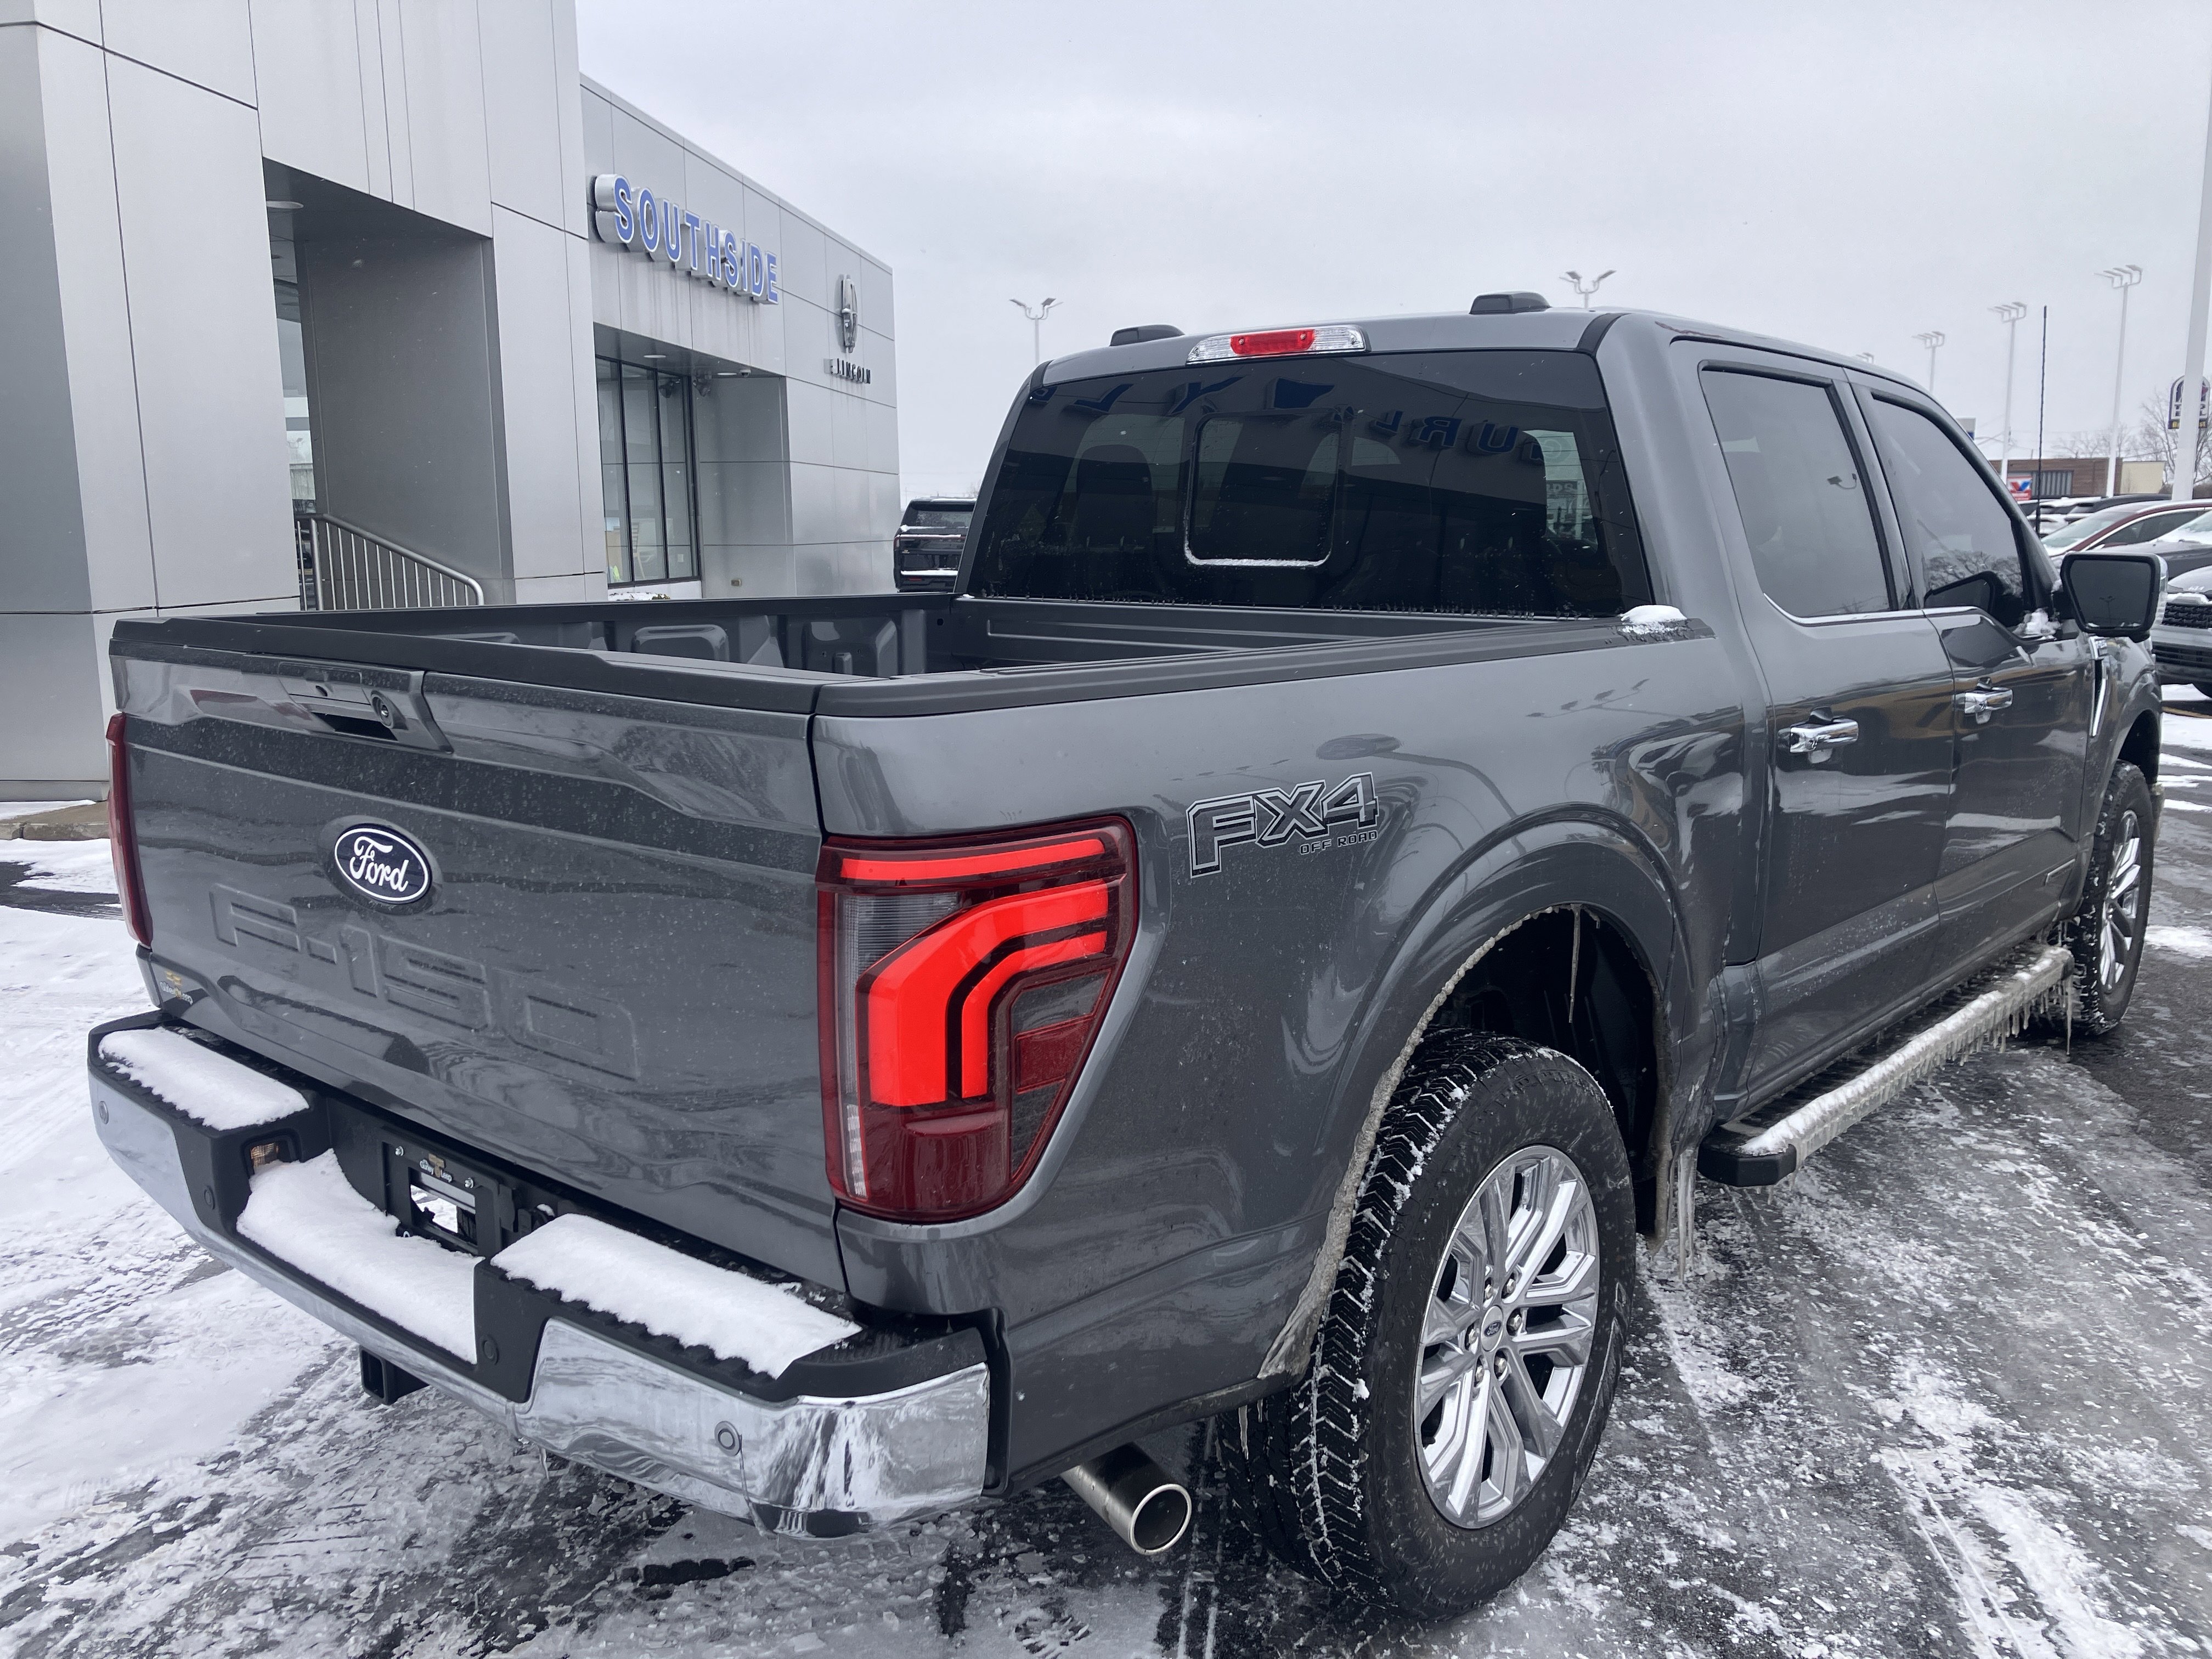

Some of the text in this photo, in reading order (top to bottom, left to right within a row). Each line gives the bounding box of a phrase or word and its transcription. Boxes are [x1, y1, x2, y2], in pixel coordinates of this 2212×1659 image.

[611, 174, 779, 305] SOUTHSIDE
[349, 836, 409, 892] Ford
[1186, 772, 1379, 878] FX4
[1300, 829, 1379, 855] OFF ROAD
[210, 883, 641, 1081] F-150
